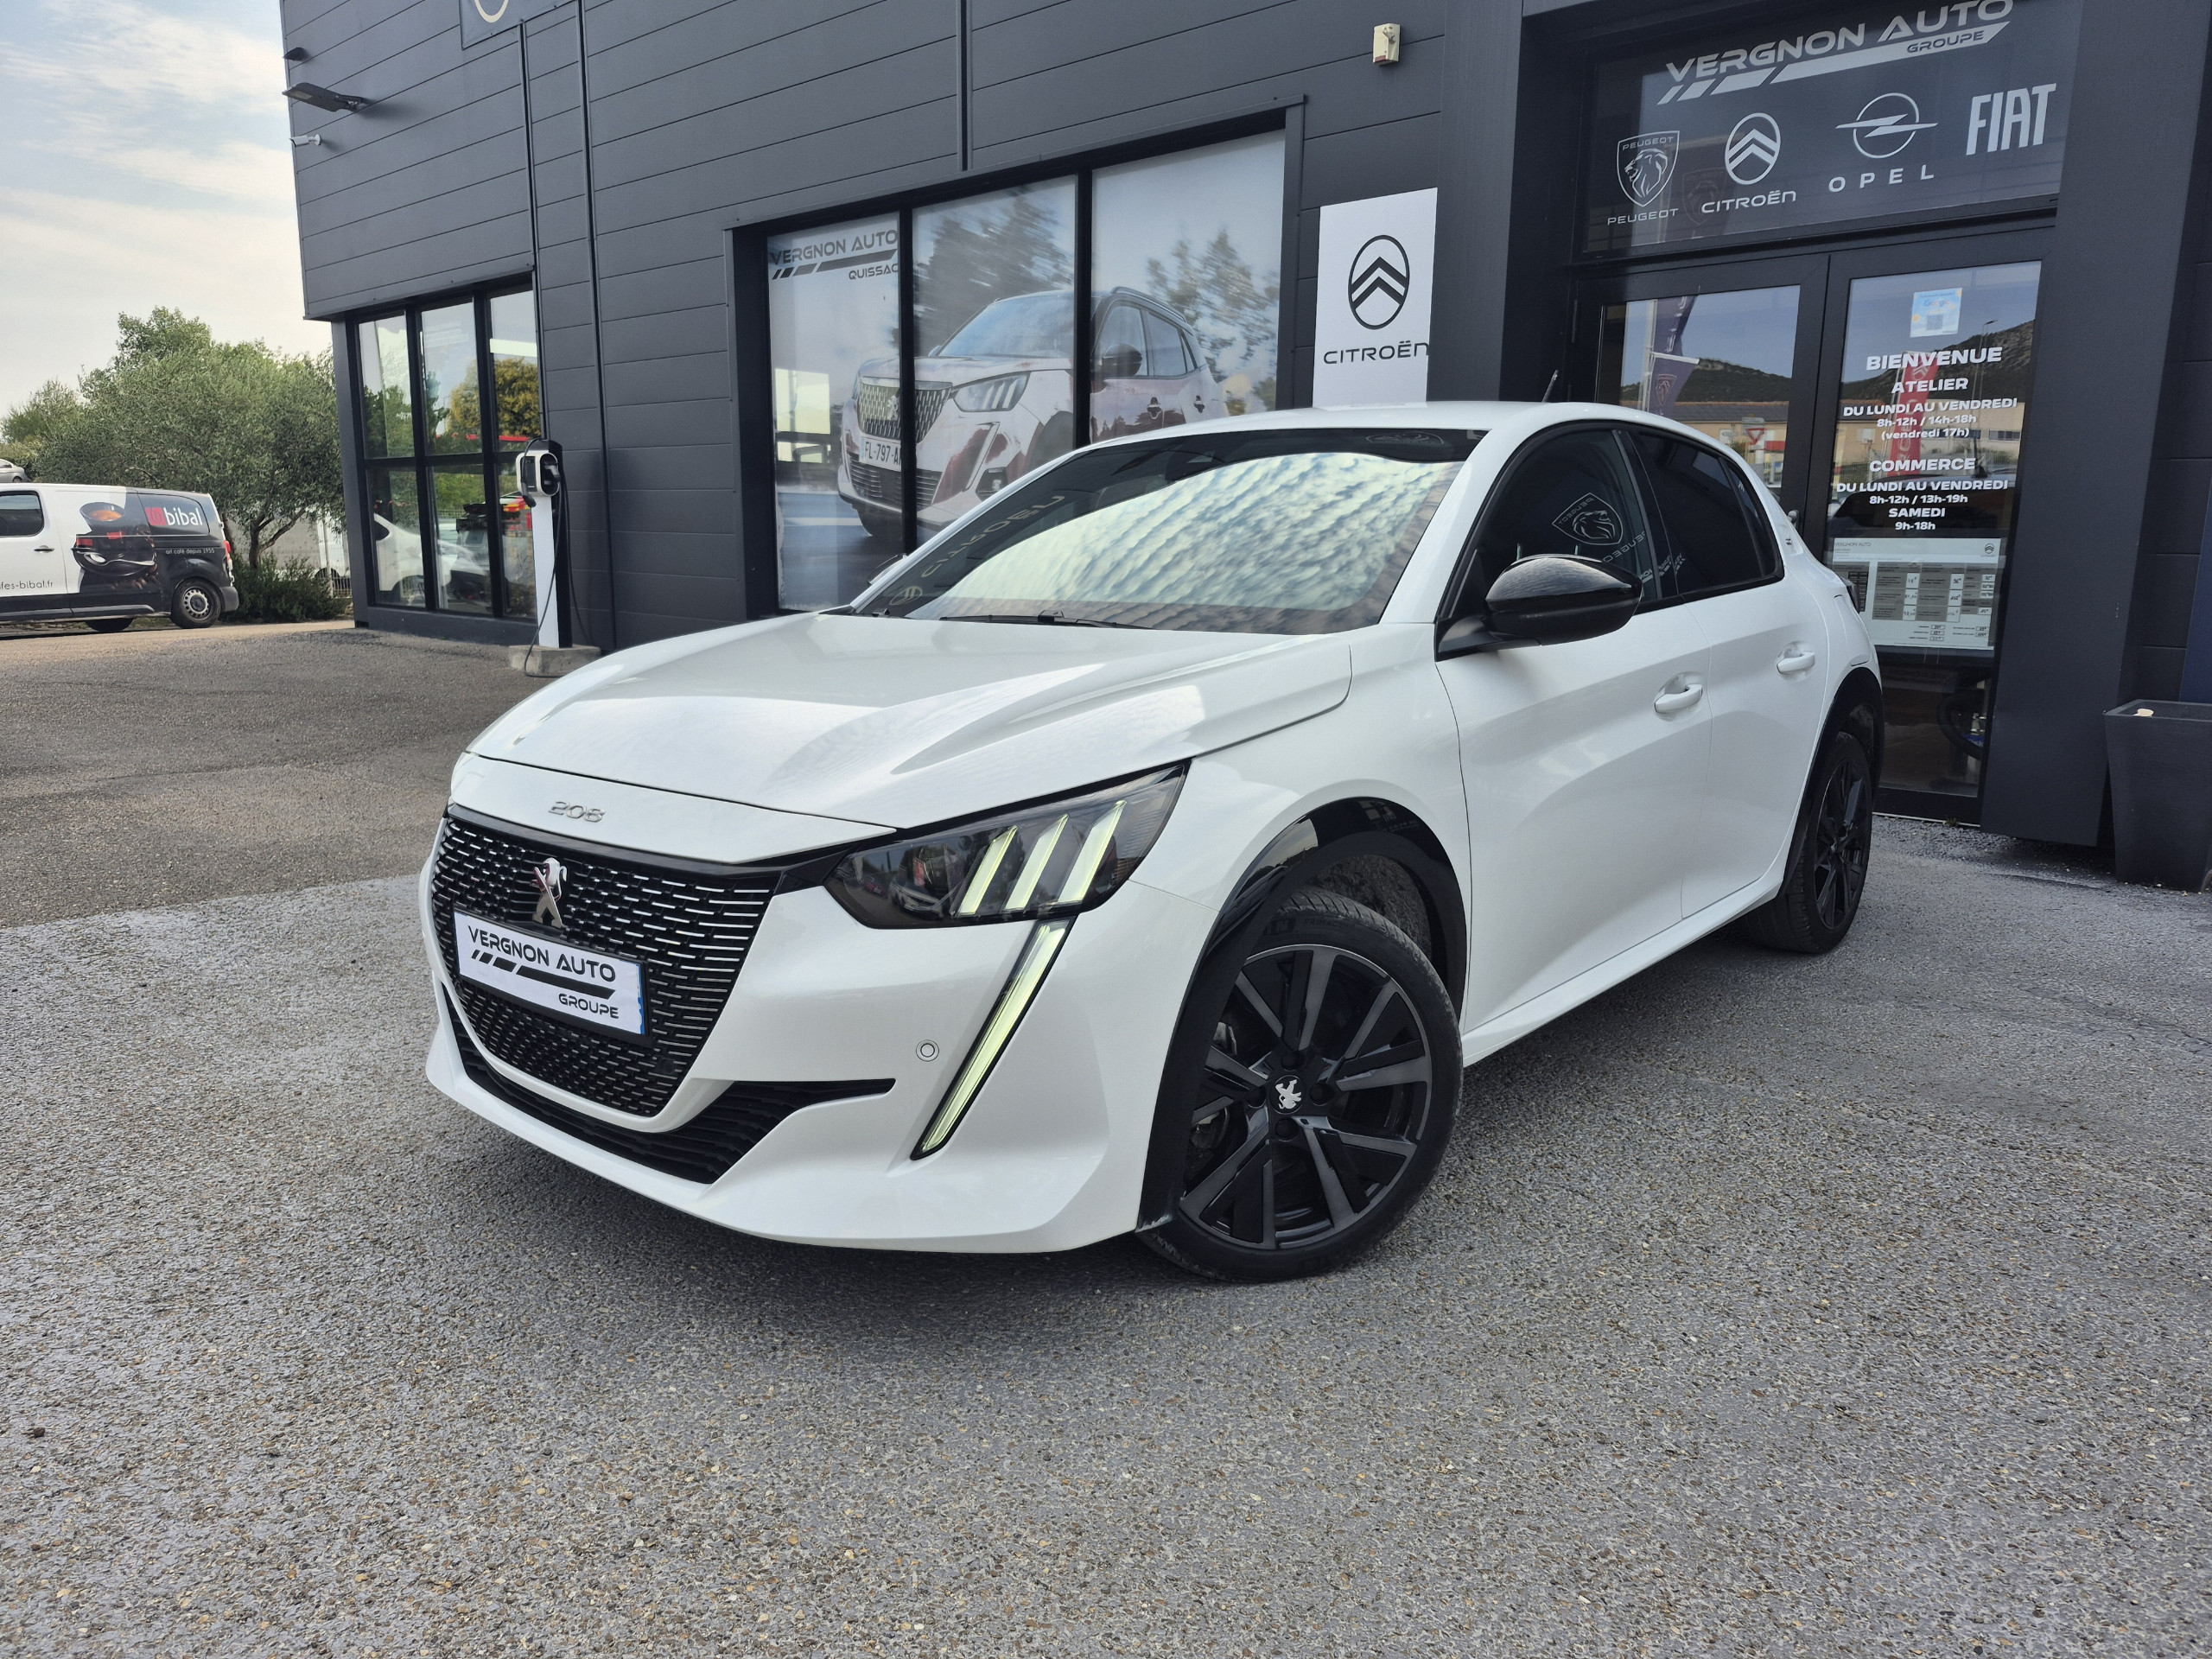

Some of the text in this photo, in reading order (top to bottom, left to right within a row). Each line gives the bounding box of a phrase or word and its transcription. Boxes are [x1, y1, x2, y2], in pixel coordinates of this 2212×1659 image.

[1666, 0, 2013, 82] VERGNON AUTO
[1907, 30, 1985, 54] GROUPE
[1966, 83, 2056, 156] FIAT
[1623, 136, 1674, 150] PEUGEOT
[1828, 164, 1935, 193] OPEL
[1607, 207, 1679, 226] PEUGEOT
[771, 229, 898, 265] VERGNON AUTO
[1866, 347, 2003, 370] BIENVENUE
[1891, 378, 1968, 393] ATELIER
[1844, 398, 2018, 416] DU LUNDI AU VENDREDI
[1877, 415, 1976, 428] 8h-12h / 14h-18h
[1881, 427, 1970, 441] (vendredi 17h)
[865, 441, 902, 466] FL-797-A
[1870, 458, 1976, 472] COMMERCE
[1837, 480, 2008, 493] DU LUNDI AU VENDREDI
[1870, 494, 1967, 505] 8h-12h / 13h-19h
[163, 507, 203, 525] bibal
[1888, 508, 1945, 518] SAMEDI
[1895, 522, 1936, 531] 9h-18h
[549, 801, 607, 823] 208
[467, 925, 616, 982] VERGNON AUTO
[558, 994, 619, 1020] GROUPE
